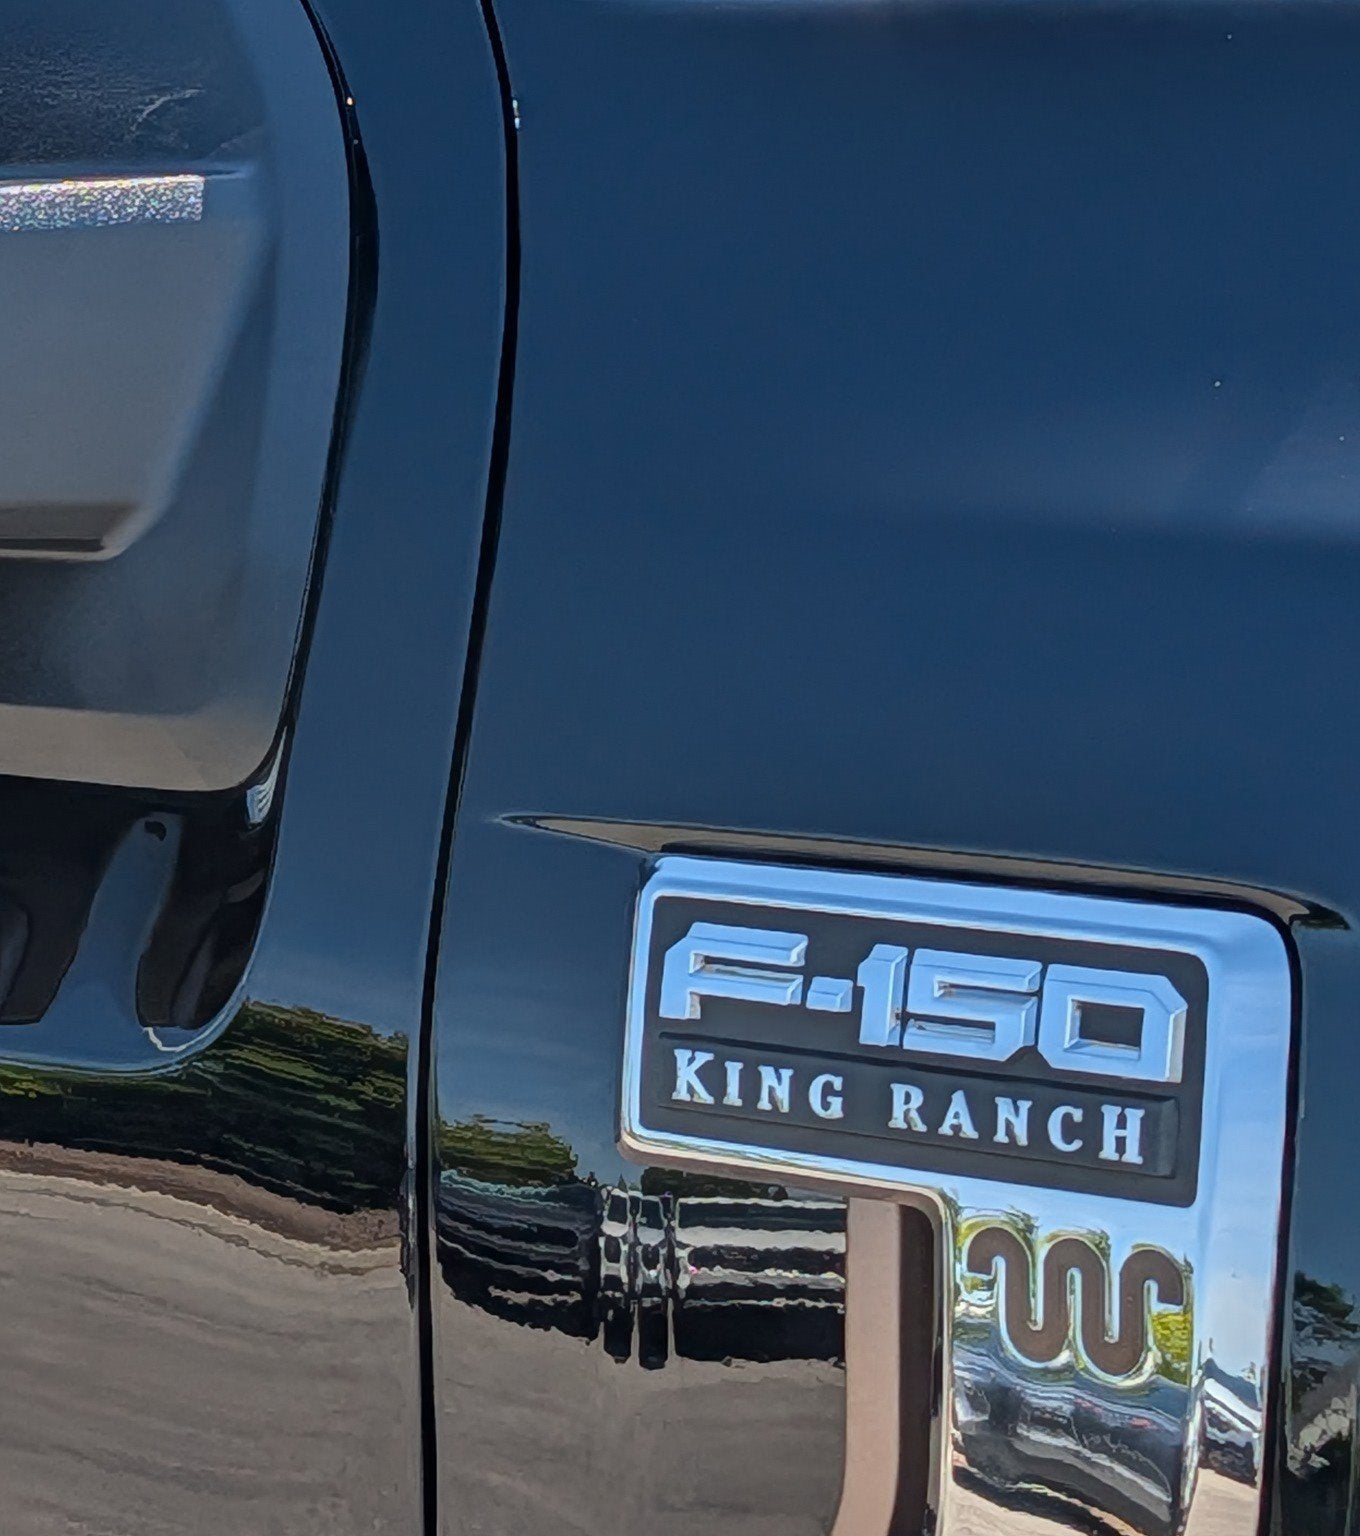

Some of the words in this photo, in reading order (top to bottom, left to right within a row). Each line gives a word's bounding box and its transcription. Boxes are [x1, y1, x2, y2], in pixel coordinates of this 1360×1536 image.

[659, 922, 1188, 1083] F-150
[671, 1049, 844, 1119] KING
[887, 1083, 1145, 1164] RANCH
